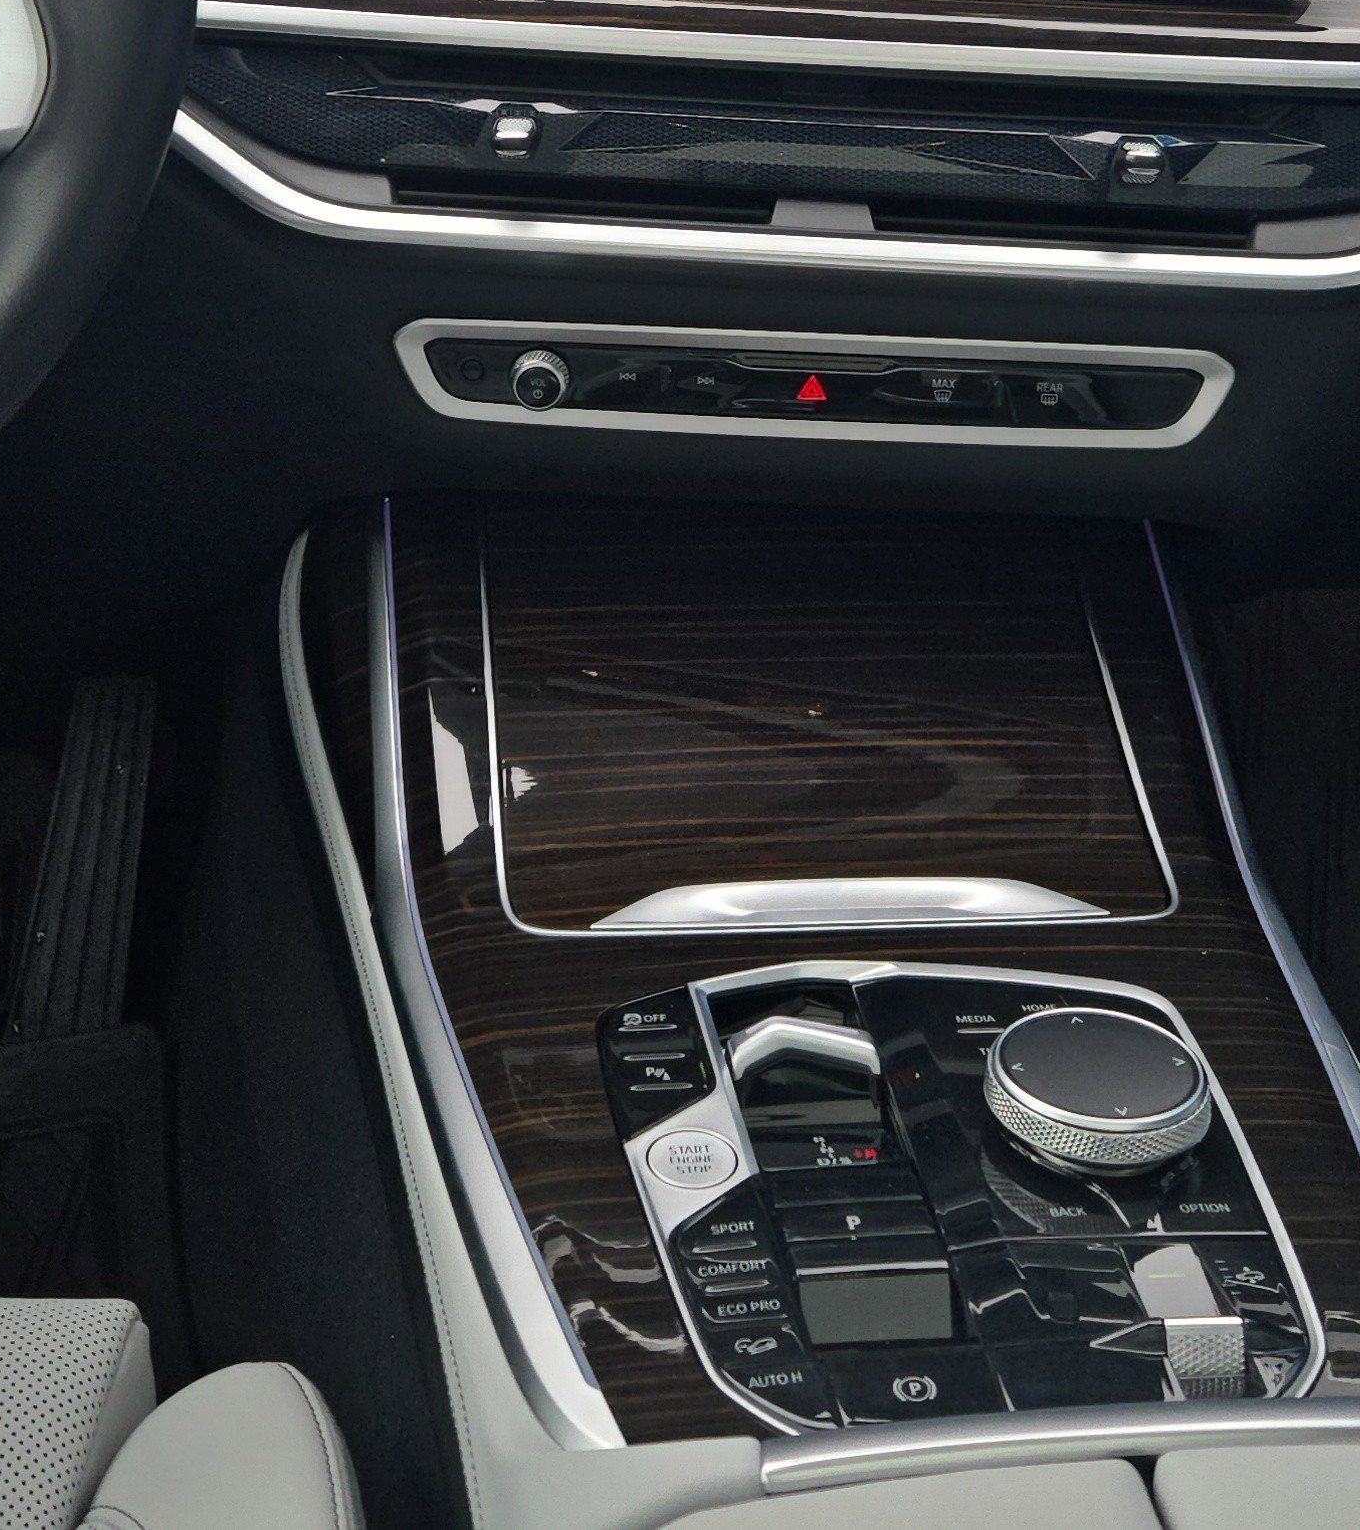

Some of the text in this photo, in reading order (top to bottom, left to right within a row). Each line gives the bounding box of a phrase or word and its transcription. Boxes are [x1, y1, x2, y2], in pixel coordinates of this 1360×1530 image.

[931, 378, 957, 389] MAX
[1036, 381, 1064, 394] REAR
[643, 1013, 667, 1023] OFF
[955, 1014, 997, 1024] MEDIA
[668, 1145, 710, 1155] START
[1048, 1206, 1088, 1219] BACK
[1178, 1202, 1231, 1215] OPTION
[709, 1220, 757, 1236] SPORT
[697, 1259, 768, 1279] COMFORT
[716, 1298, 781, 1317] ECO PRO
[748, 1370, 804, 1390] AUTO H
